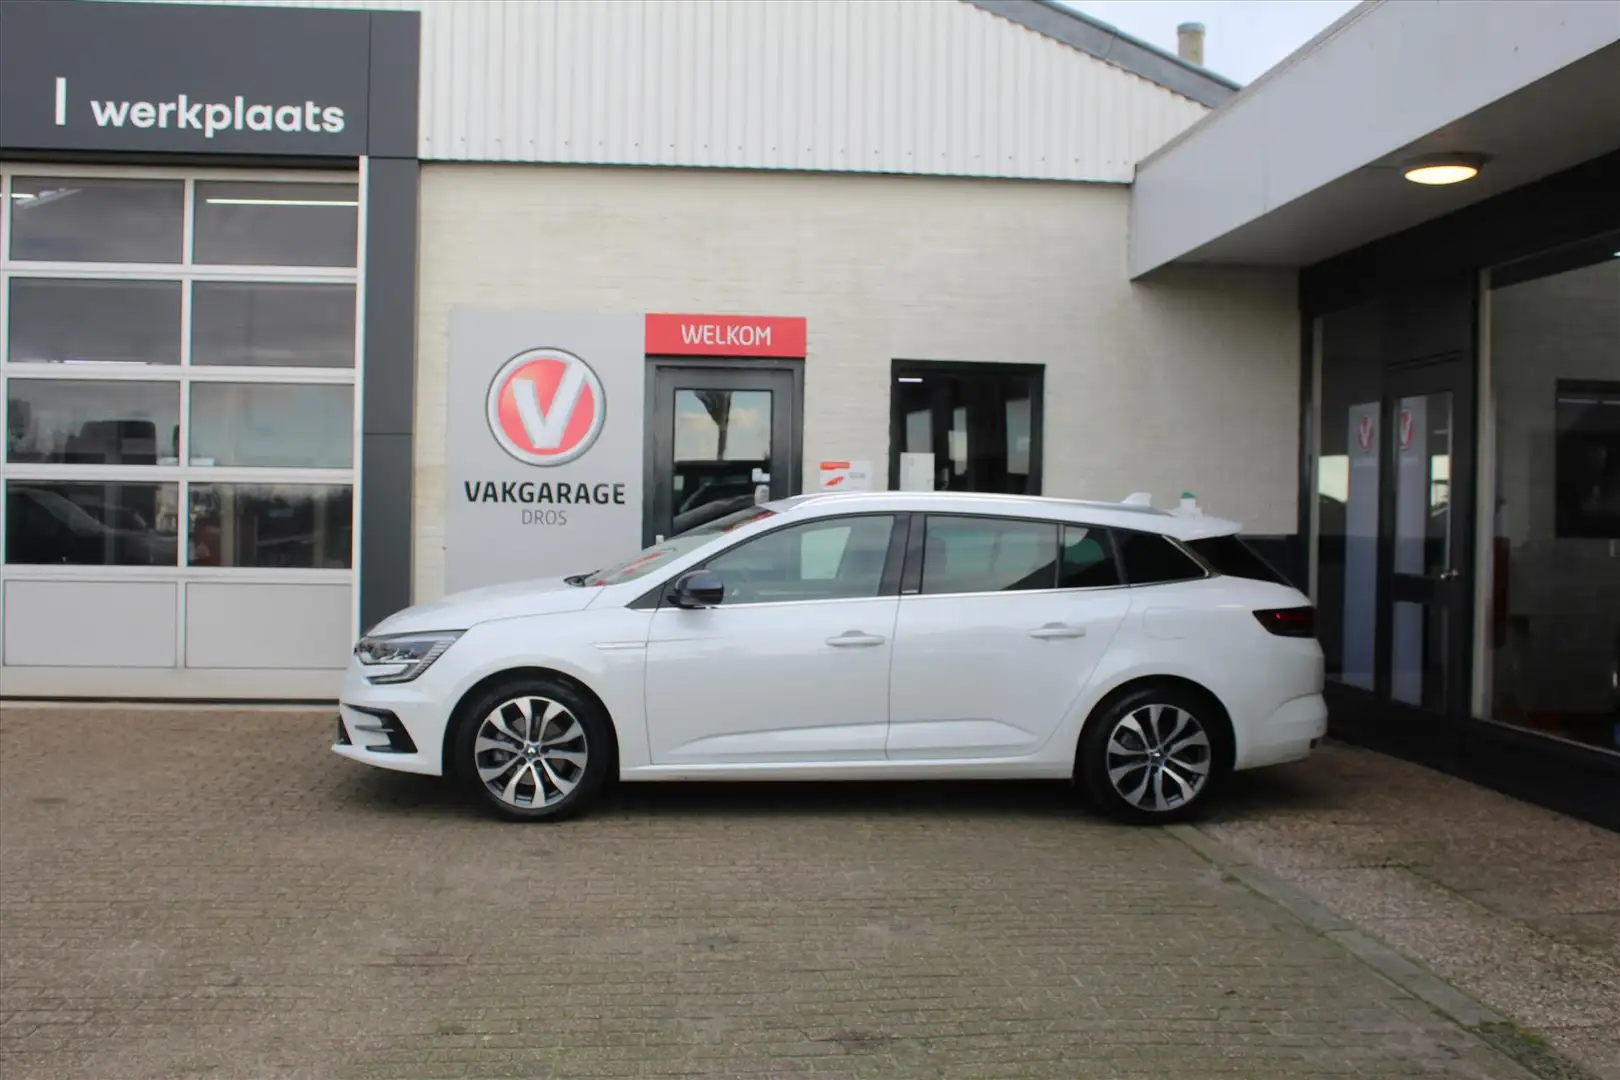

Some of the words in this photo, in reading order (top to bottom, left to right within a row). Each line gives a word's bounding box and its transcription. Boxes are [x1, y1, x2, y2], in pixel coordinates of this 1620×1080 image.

[90, 93, 345, 139] werkplaats
[681, 323, 772, 346] WELKOM
[464, 480, 626, 505] VAKGARAGE
[521, 509, 567, 526] DROS
